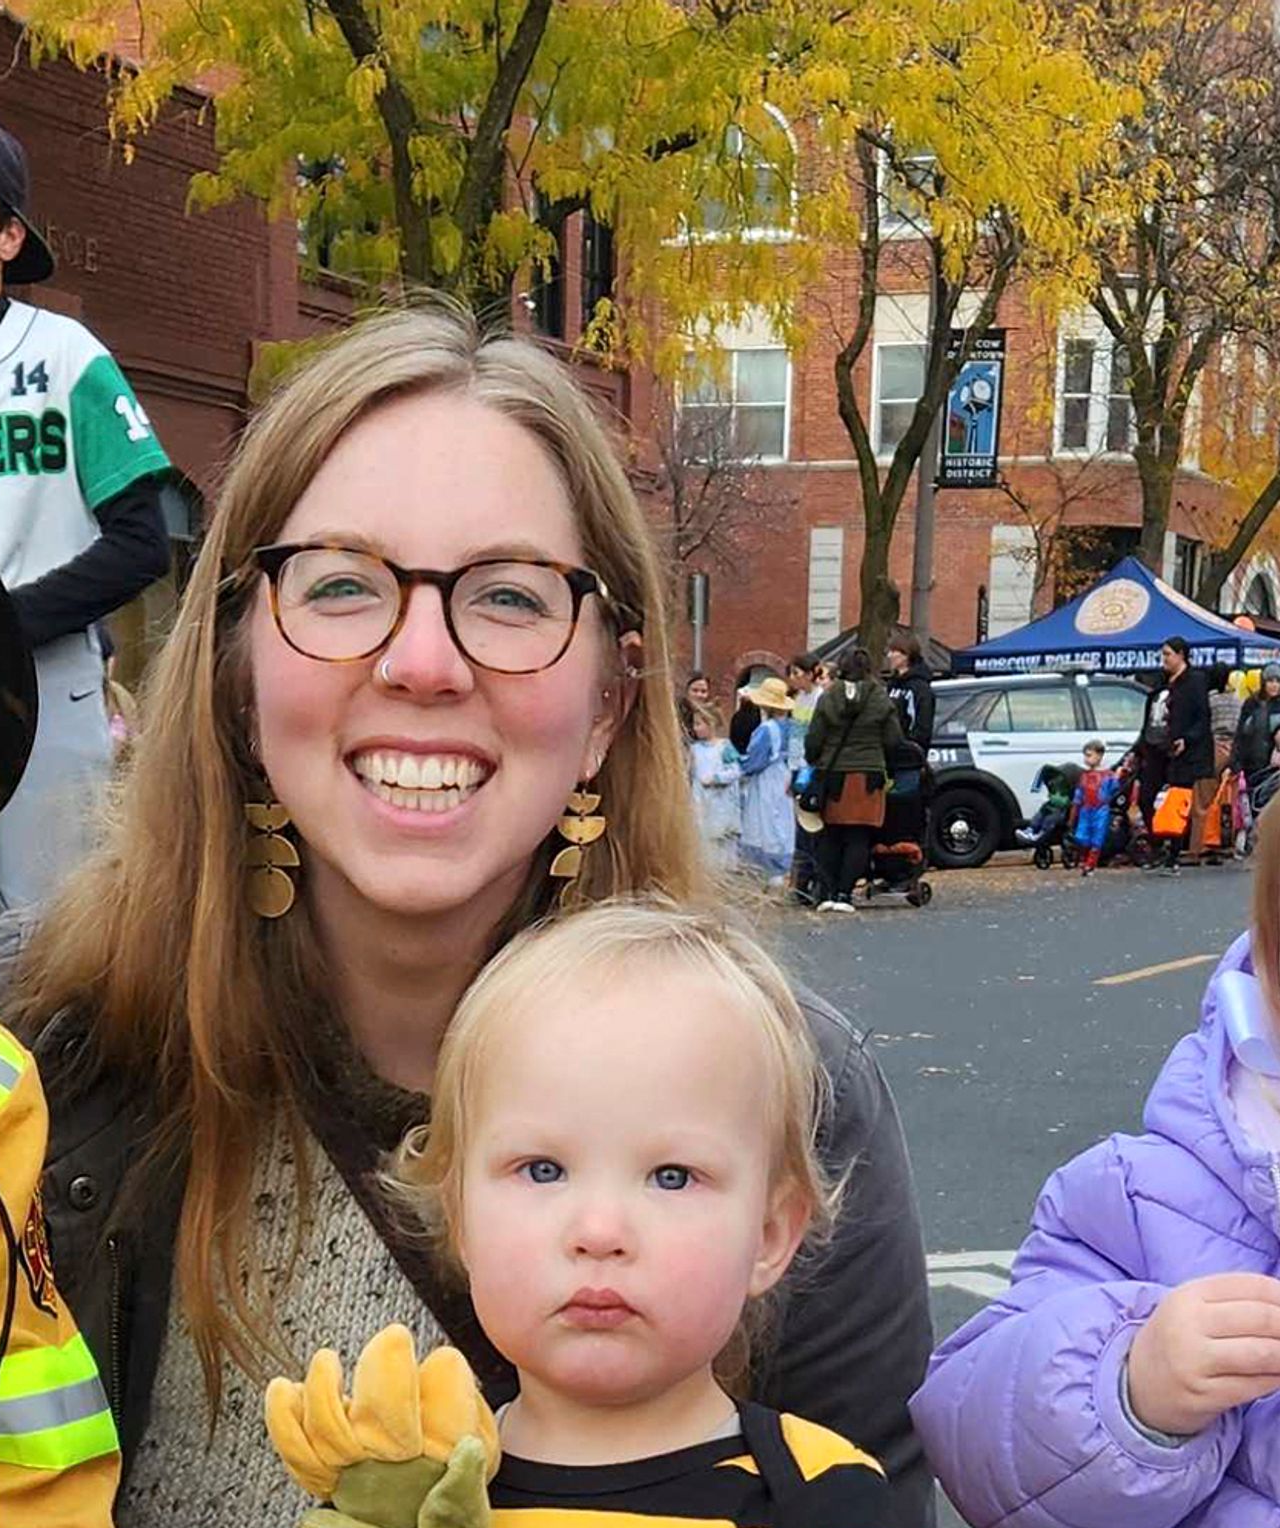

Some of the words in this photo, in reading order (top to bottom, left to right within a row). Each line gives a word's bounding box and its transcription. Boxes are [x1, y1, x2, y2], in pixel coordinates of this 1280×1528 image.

[10, 360, 49, 396] 14
[945, 457, 994, 467] HISTORIC
[945, 468, 992, 479] DISTRICT
[975, 655, 1041, 672] MOSCOW
[1045, 653, 1102, 671] POLICE
